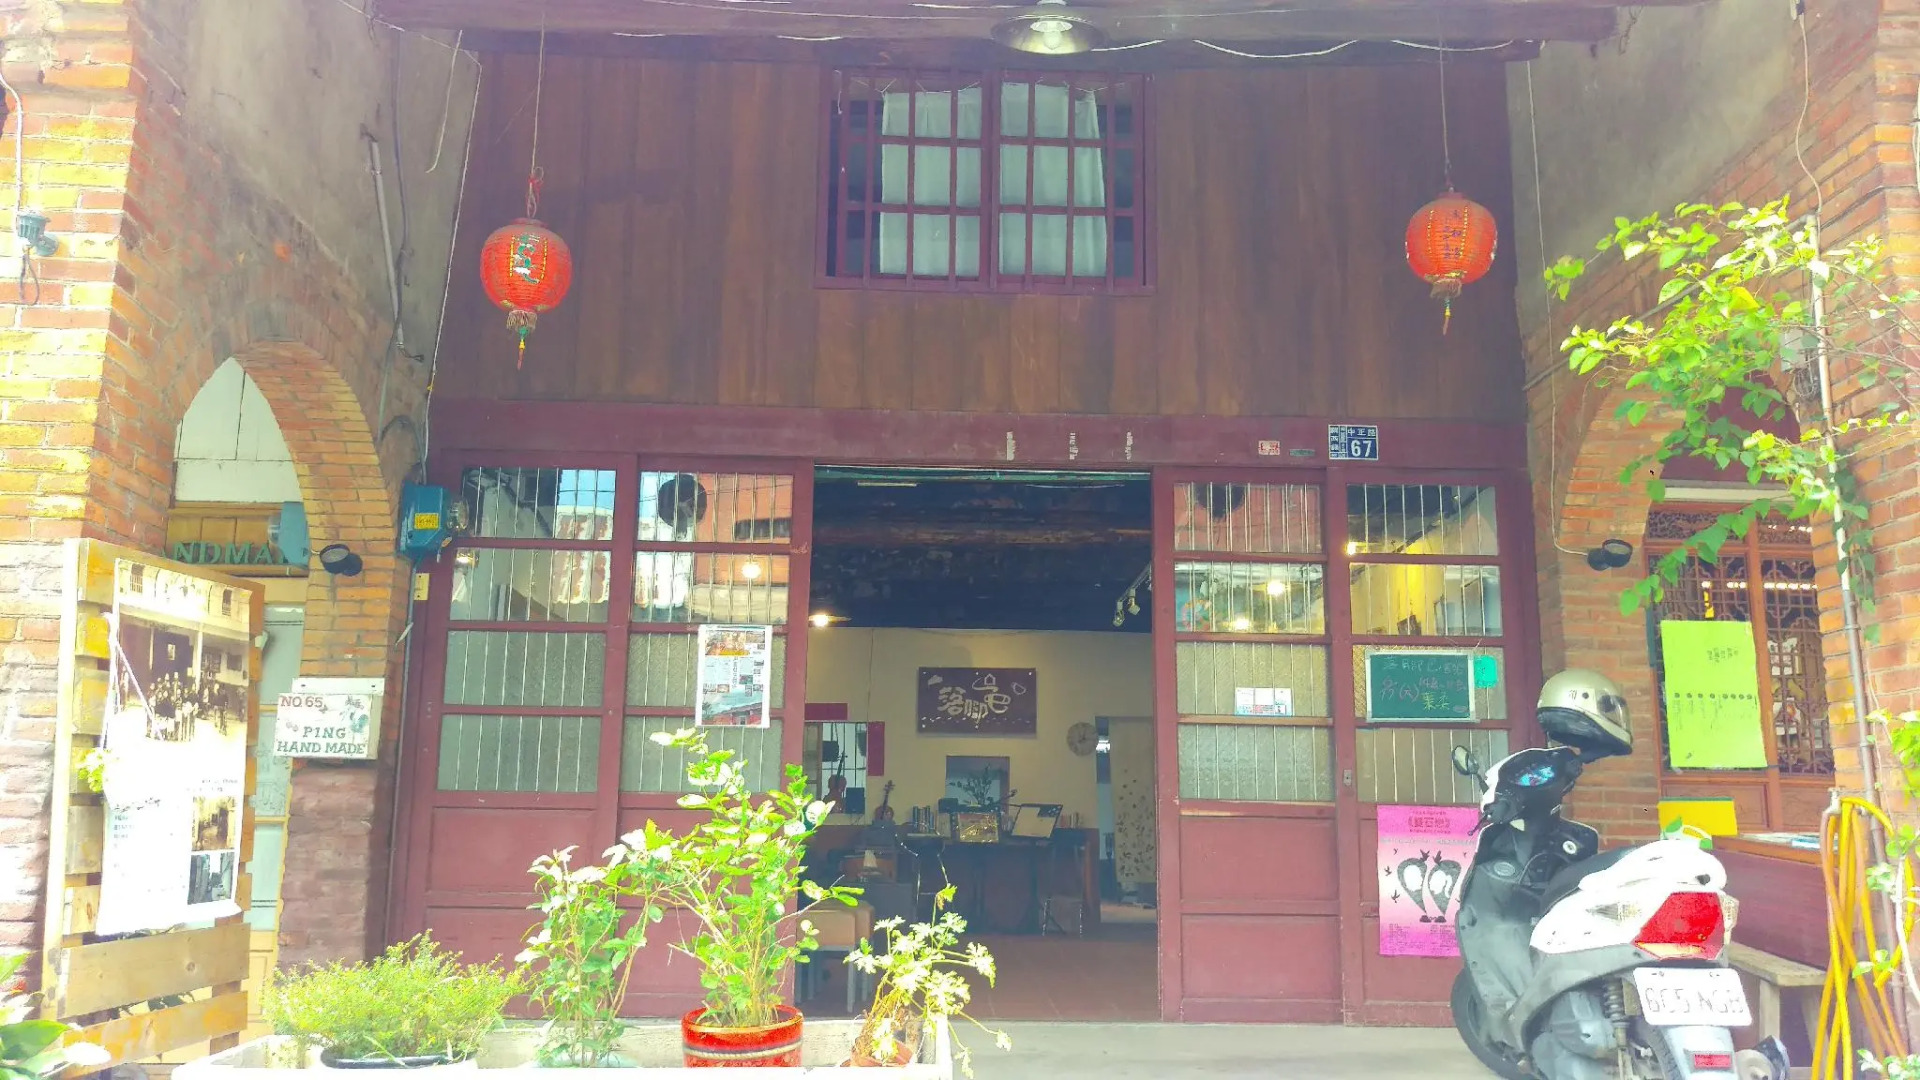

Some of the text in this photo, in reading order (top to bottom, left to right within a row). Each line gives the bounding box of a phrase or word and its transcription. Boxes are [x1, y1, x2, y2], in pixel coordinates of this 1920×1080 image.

[1347, 427, 1376, 437] 中正路
[1351, 439, 1372, 458] 67
[303, 726, 347, 739] PING
[277, 740, 366, 755] HAND MADE
